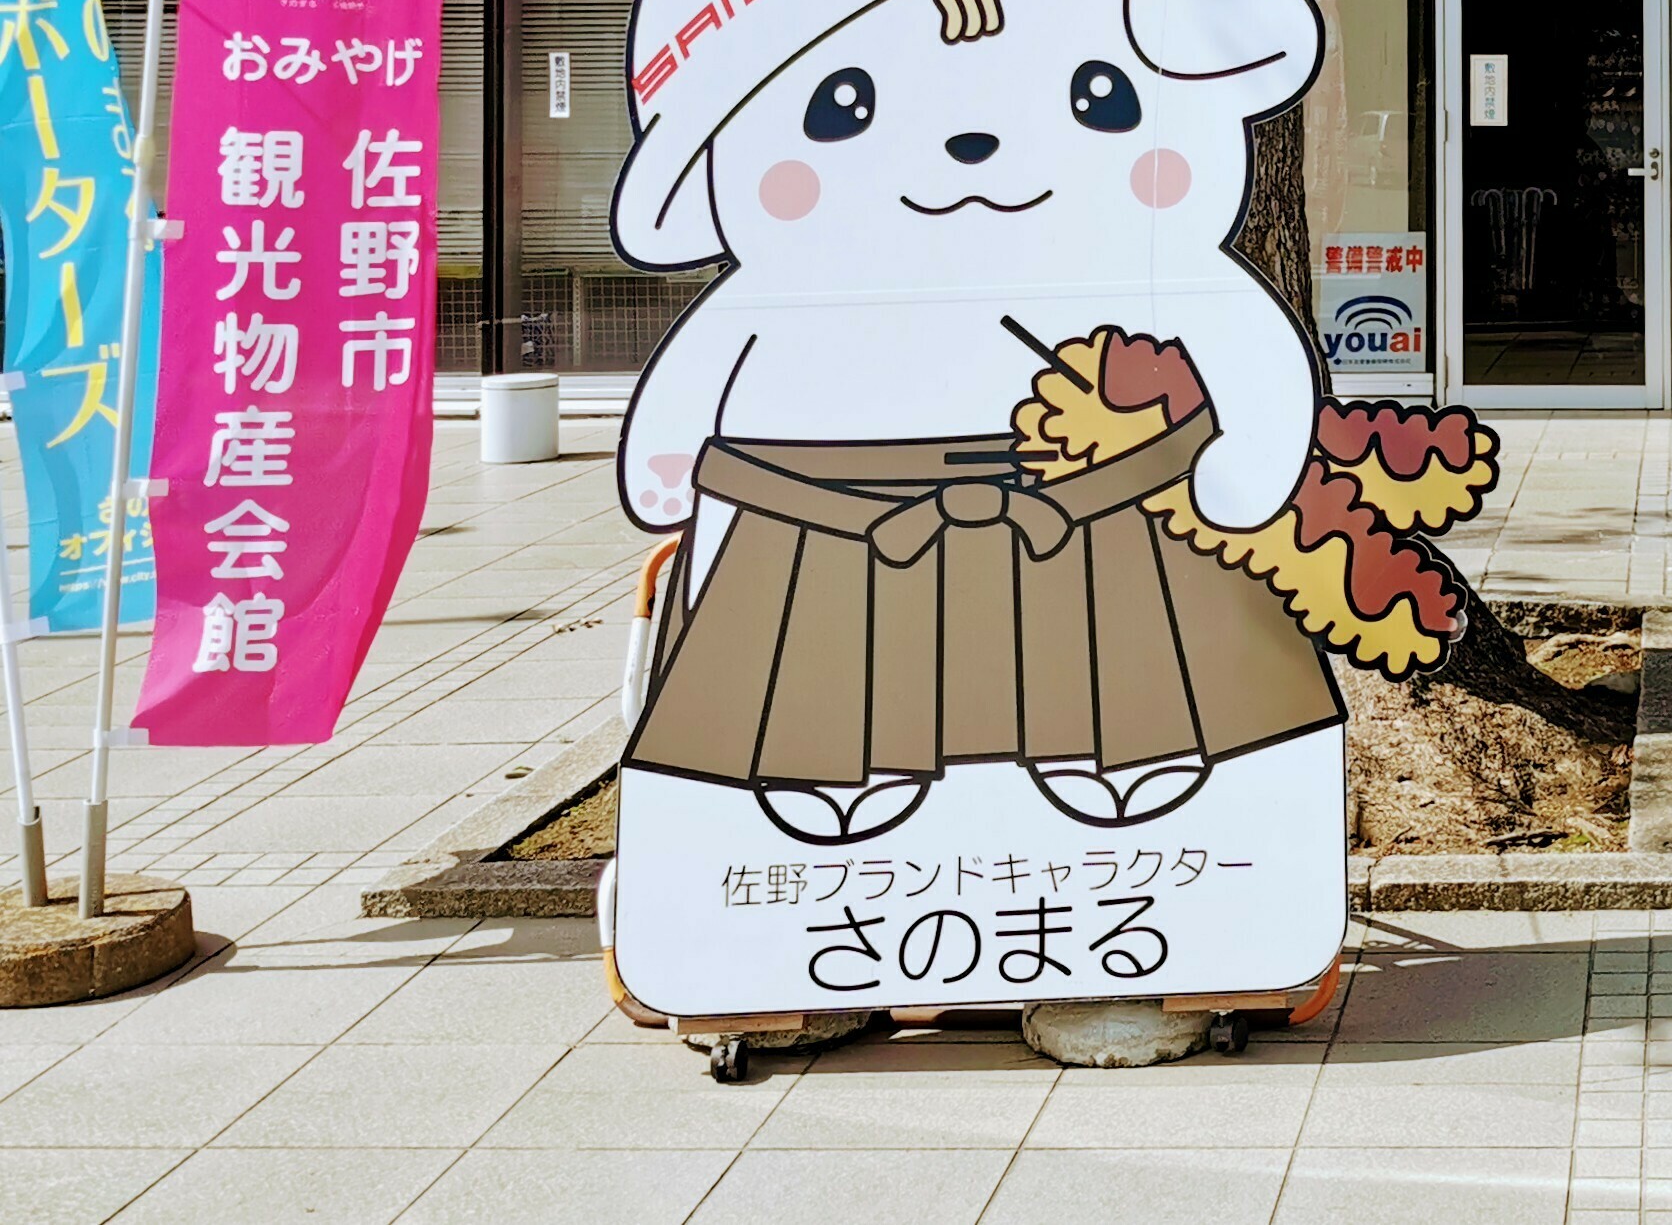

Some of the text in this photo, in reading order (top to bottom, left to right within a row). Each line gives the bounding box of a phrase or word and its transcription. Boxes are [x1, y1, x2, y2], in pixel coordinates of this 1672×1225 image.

[222, 30, 423, 86] おみやげ
[339, 127, 423, 392] 佐野市
[1324, 327, 1421, 358] youai
[192, 126, 305, 673] 観光物産会館
[721, 847, 1253, 908] 佐野ブランドキャラクター
[806, 895, 1169, 992] さのまる
